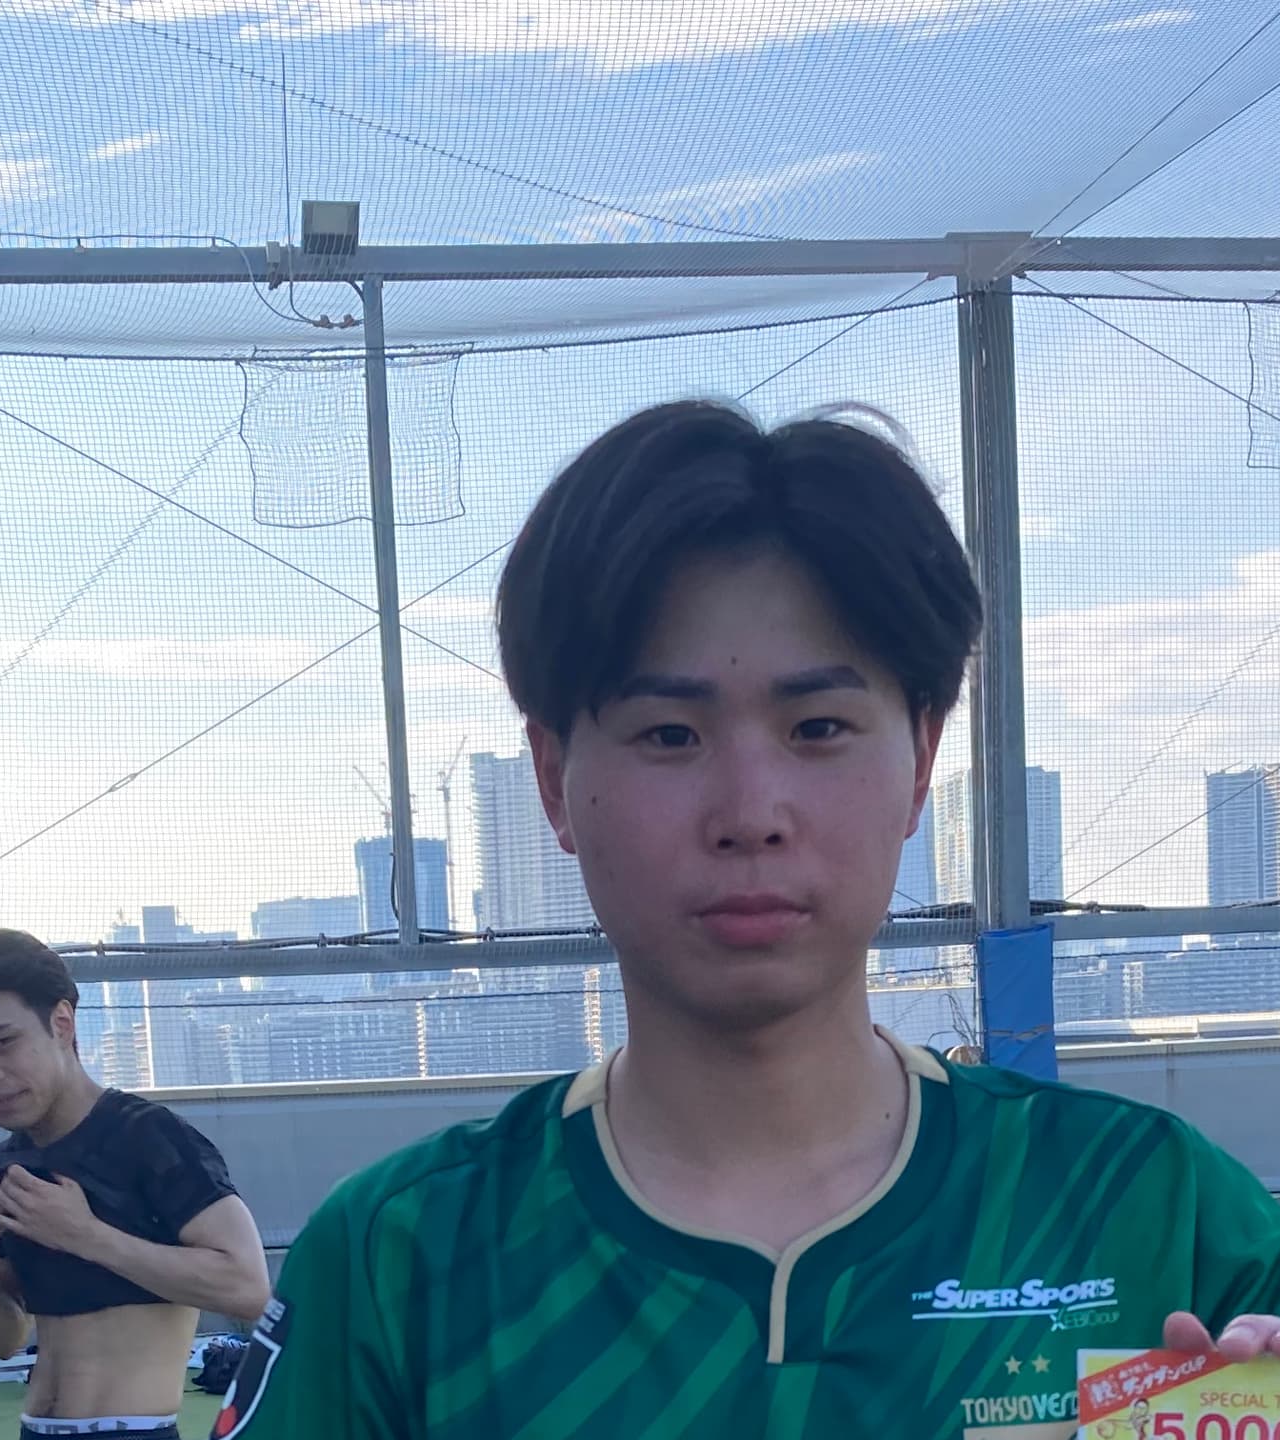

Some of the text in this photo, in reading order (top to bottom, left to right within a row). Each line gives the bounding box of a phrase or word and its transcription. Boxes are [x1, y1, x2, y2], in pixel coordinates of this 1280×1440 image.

[911, 1290, 933, 1301] THE
[932, 1279, 1019, 1309] SUPER
[1199, 1391, 1268, 1410] SPECIAL
